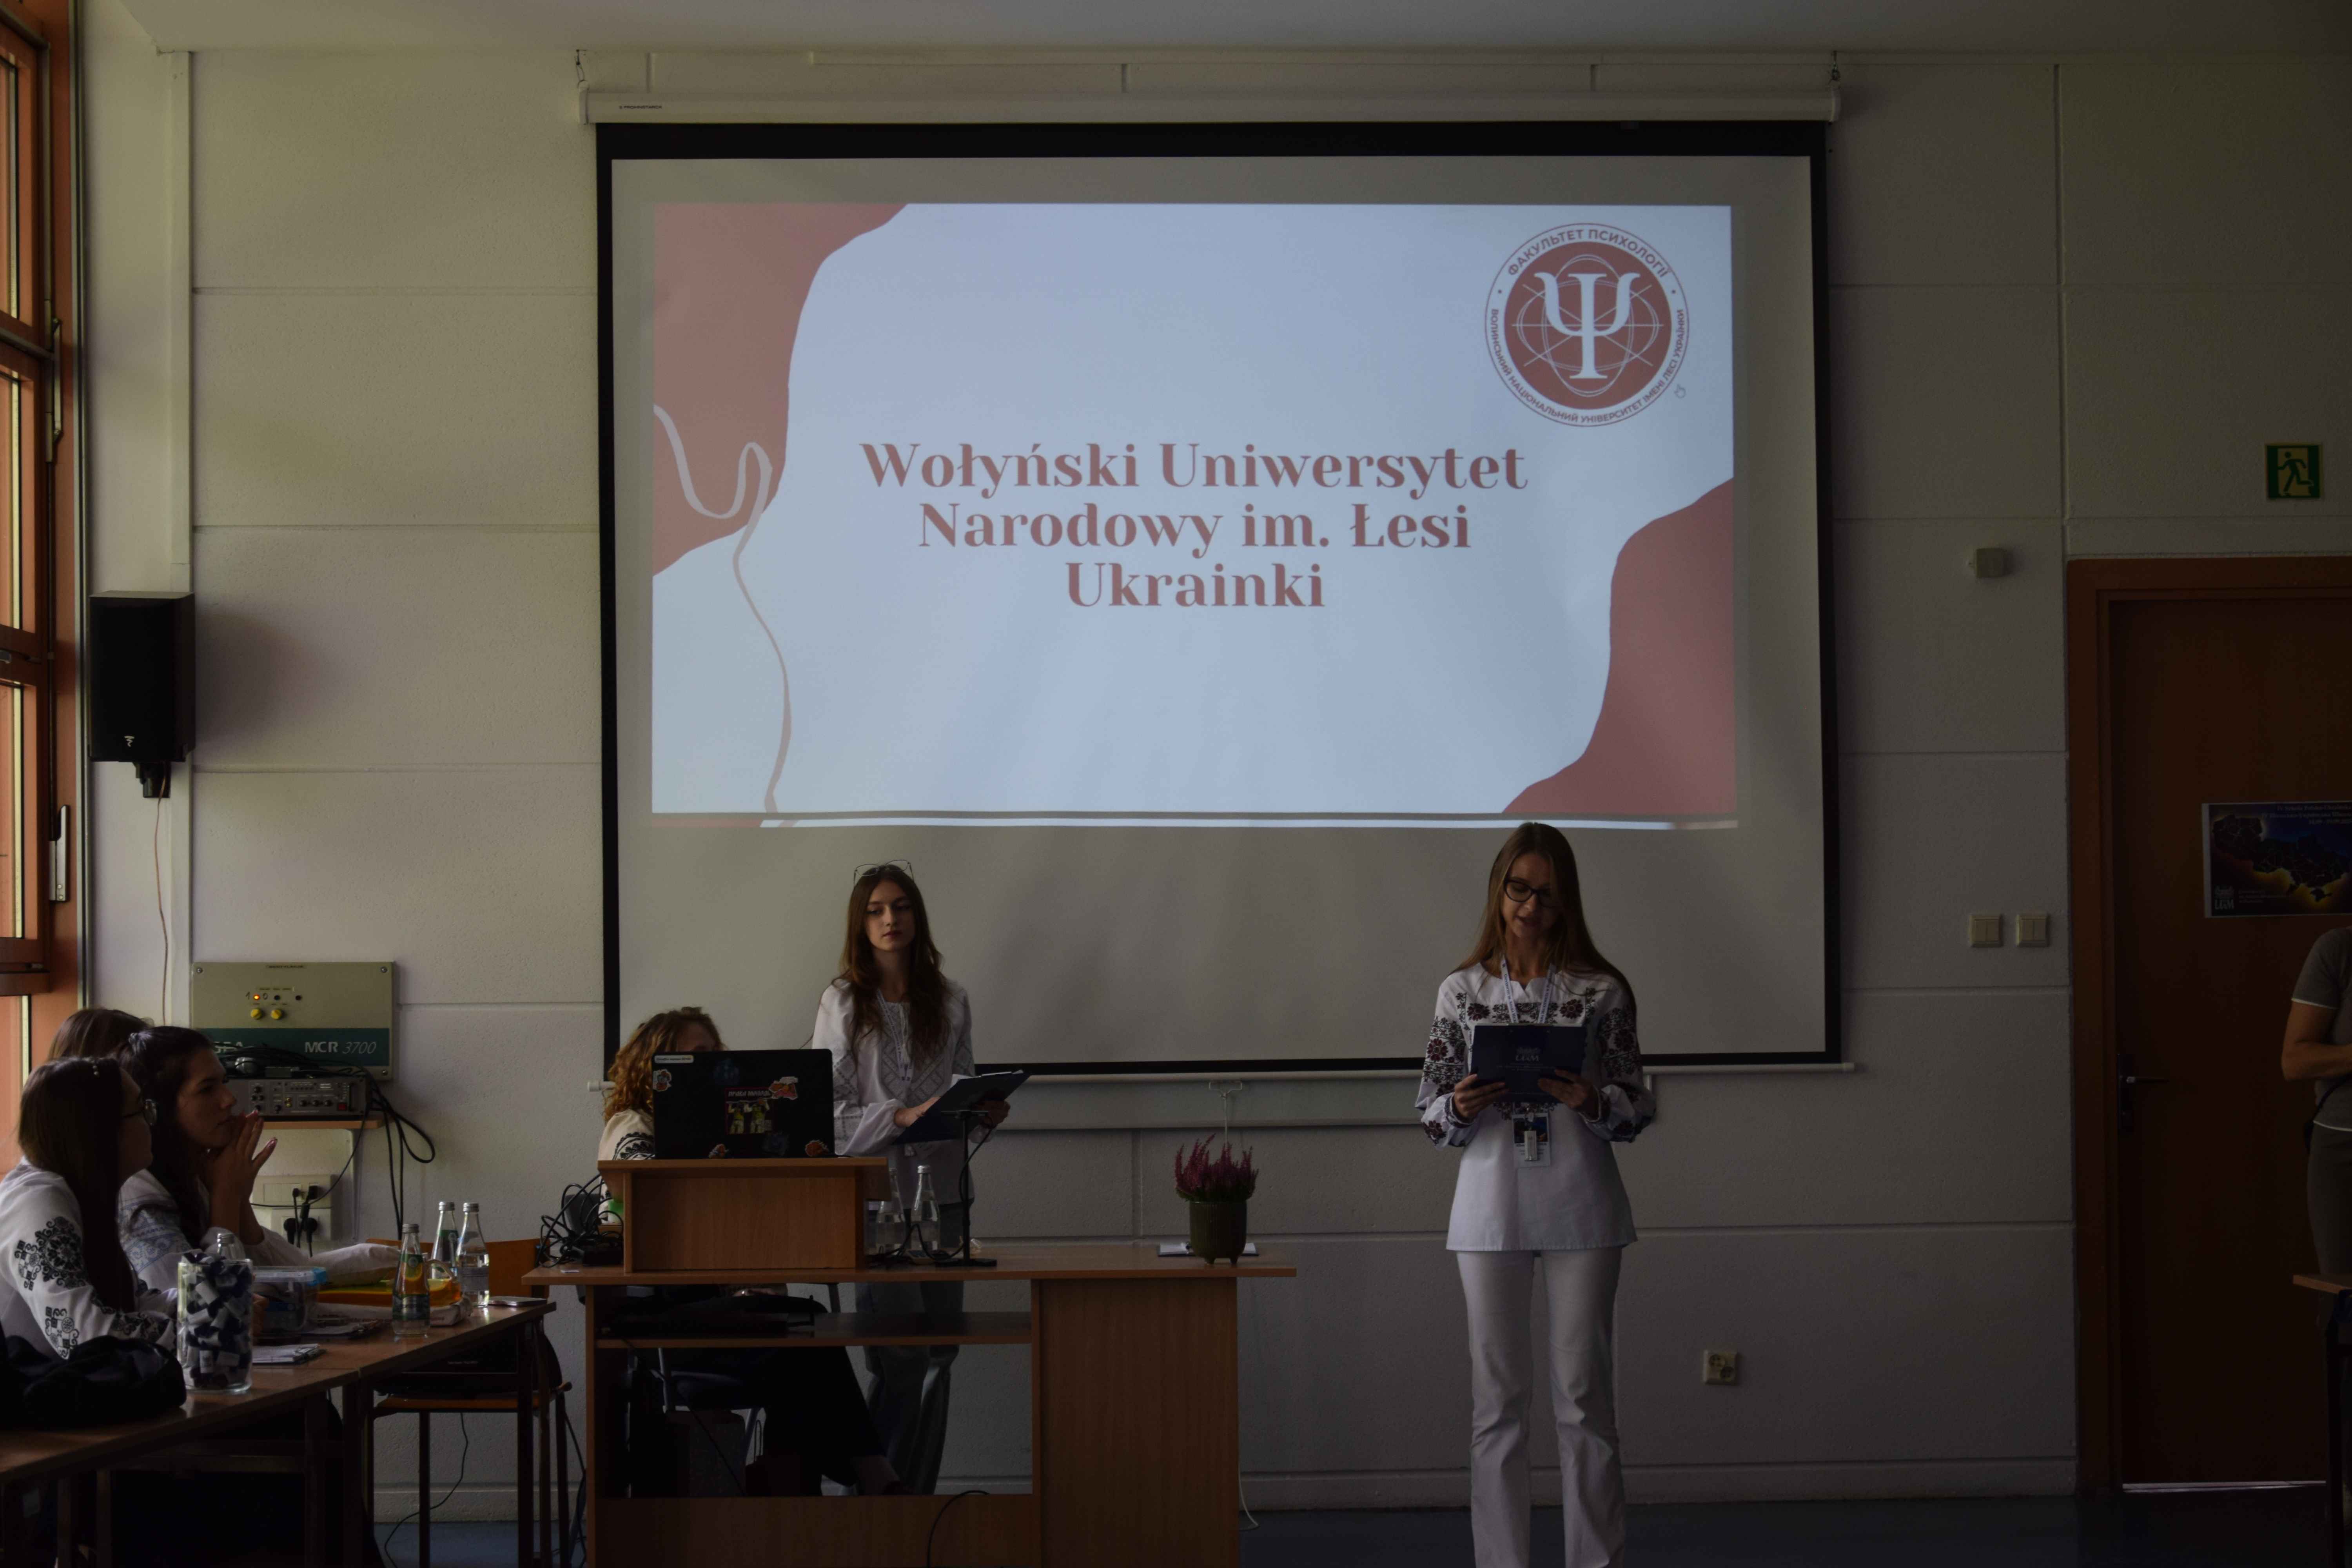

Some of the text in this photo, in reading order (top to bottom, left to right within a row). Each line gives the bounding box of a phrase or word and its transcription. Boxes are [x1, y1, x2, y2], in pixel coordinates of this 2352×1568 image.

[1508, 229, 1671, 278] ФАКУЛЬТЕТ ПСИХОЛОГІЇ
[1490, 308, 1684, 423] ВОЛИНСЬКИЙ НАЦІОНАЛЬНИЙ УНІВЕРСИТЕТ ІМЕНІ ЛЕСІ УКРАЇНКИ
[859, 443, 1528, 499] Wołyński Uniwersytet
[919, 503, 1471, 559] Narodowy im. Łesi
[1065, 563, 1325, 607] Ukrainki
[304, 1041, 377, 1054] MCR 3700
